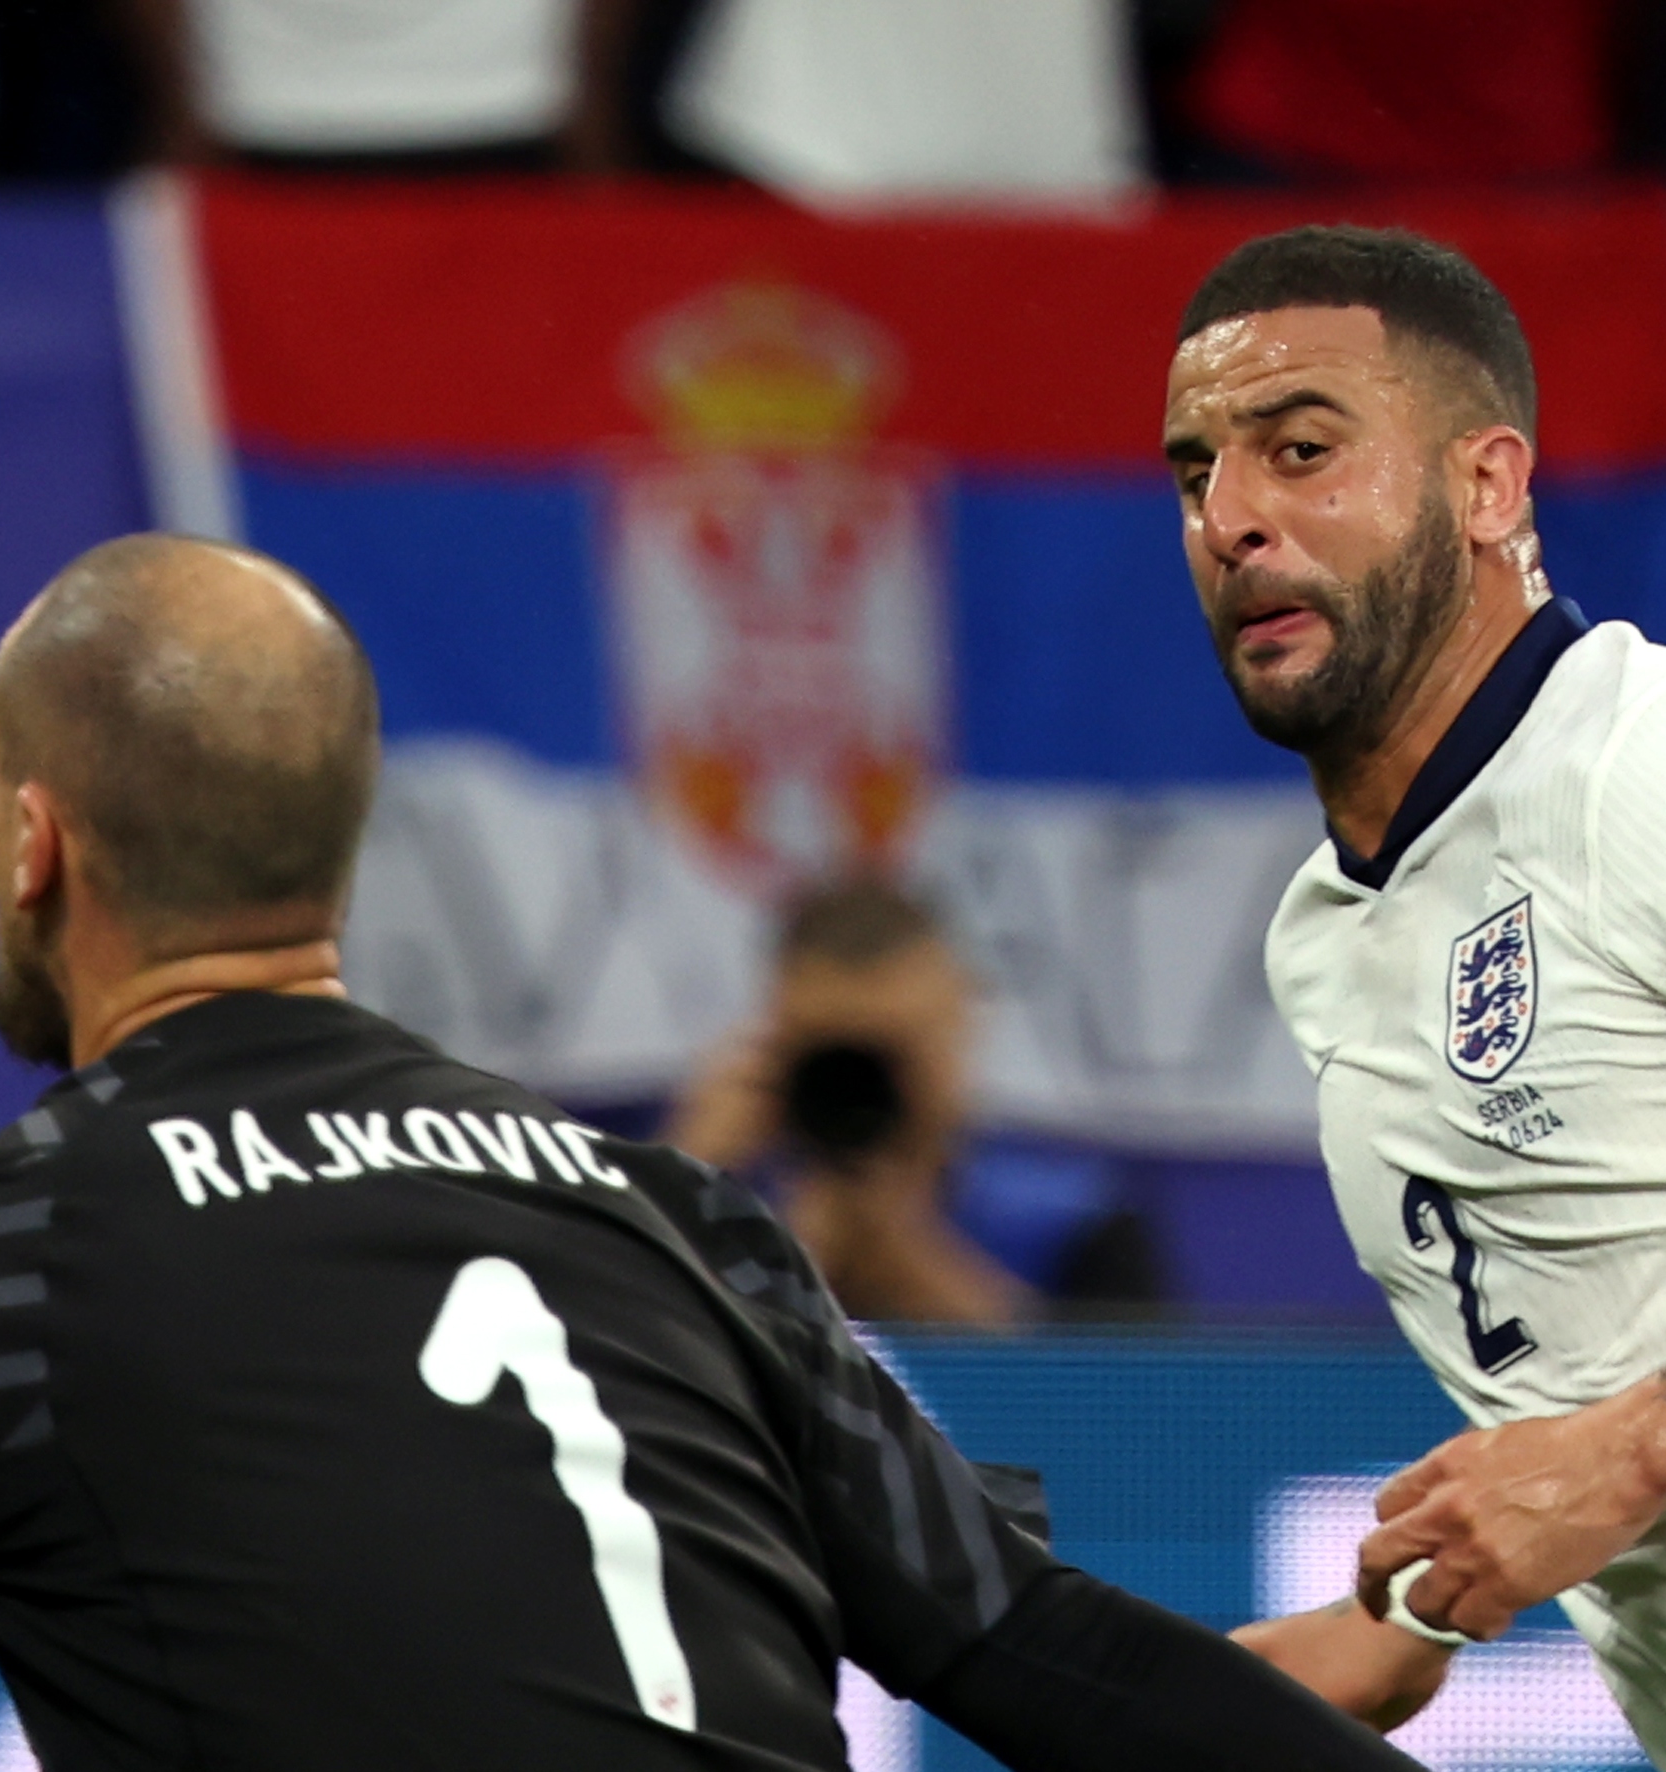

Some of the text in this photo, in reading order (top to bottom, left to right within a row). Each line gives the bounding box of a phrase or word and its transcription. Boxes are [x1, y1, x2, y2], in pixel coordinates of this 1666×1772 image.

[147, 1107, 629, 1206] RAJKOVIC
[1477, 1083, 1544, 1127] SERBIA
[1403, 1174, 1539, 1376] 2
[418, 1255, 697, 1733] 1
